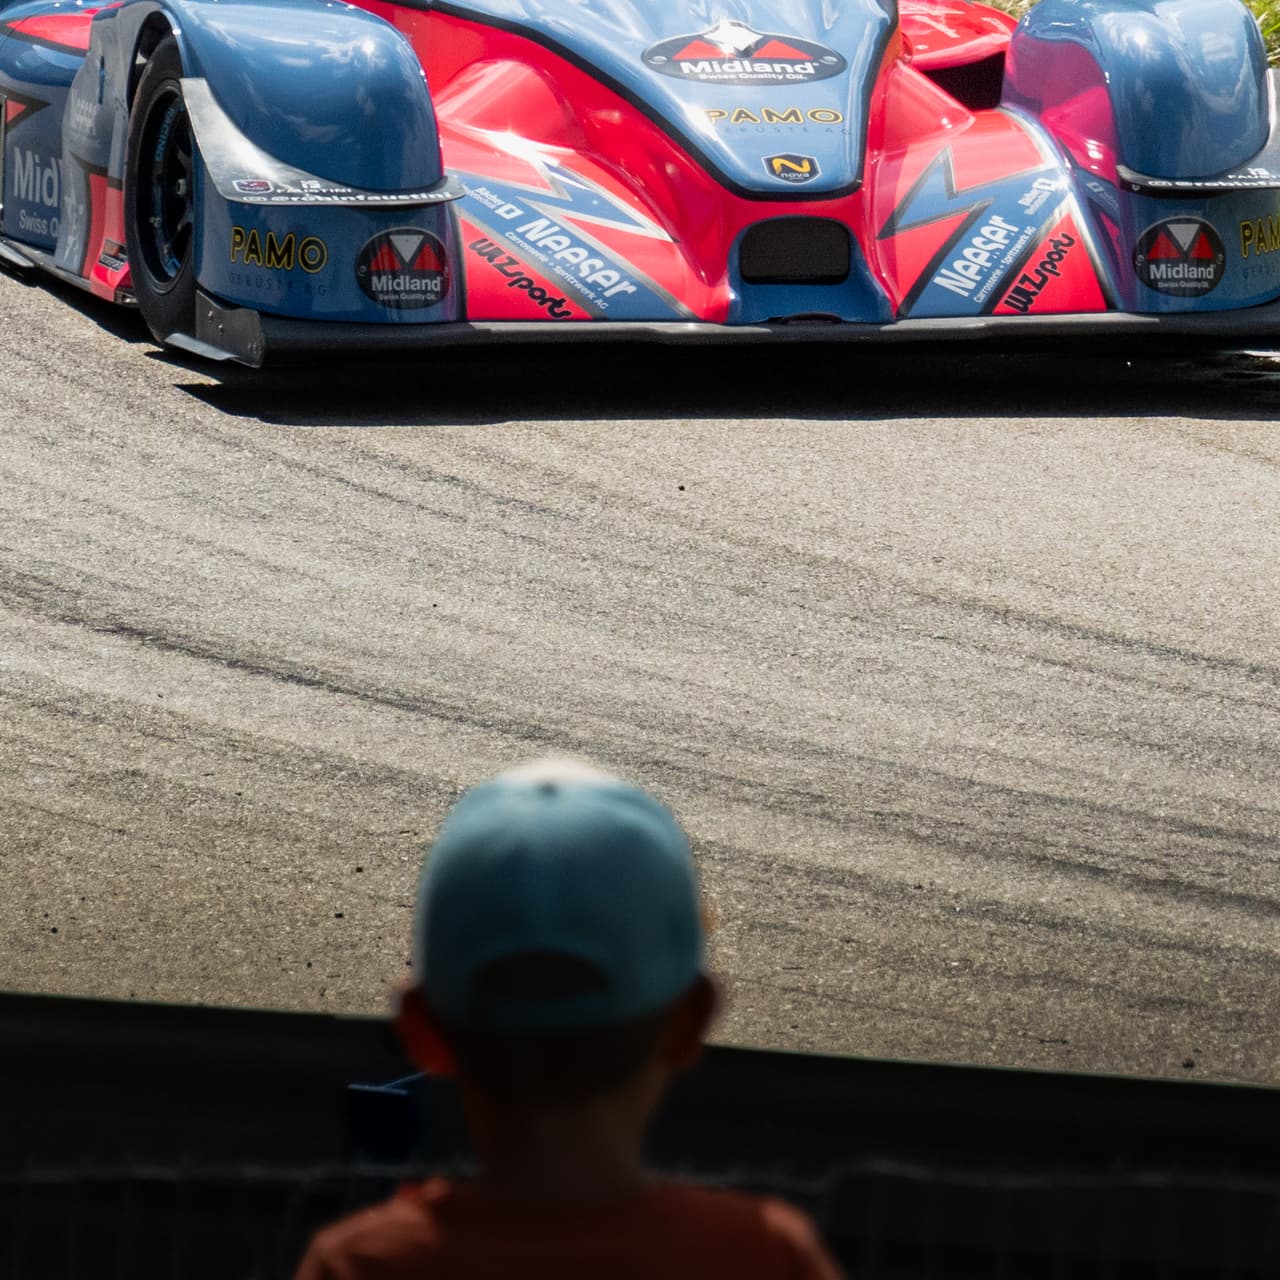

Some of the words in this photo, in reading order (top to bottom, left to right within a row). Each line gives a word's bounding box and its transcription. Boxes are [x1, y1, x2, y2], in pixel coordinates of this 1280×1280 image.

[680, 61, 815, 75] Midland
[704, 107, 844, 124] PAMO
[19, 208, 49, 234] Swiss
[230, 226, 328, 273] PAMO
[1149, 263, 1215, 280] Midland
[371, 275, 443, 292] Midland
[553, 265, 597, 303] Spritzwerk
[596, 298, 609, 310] AG
